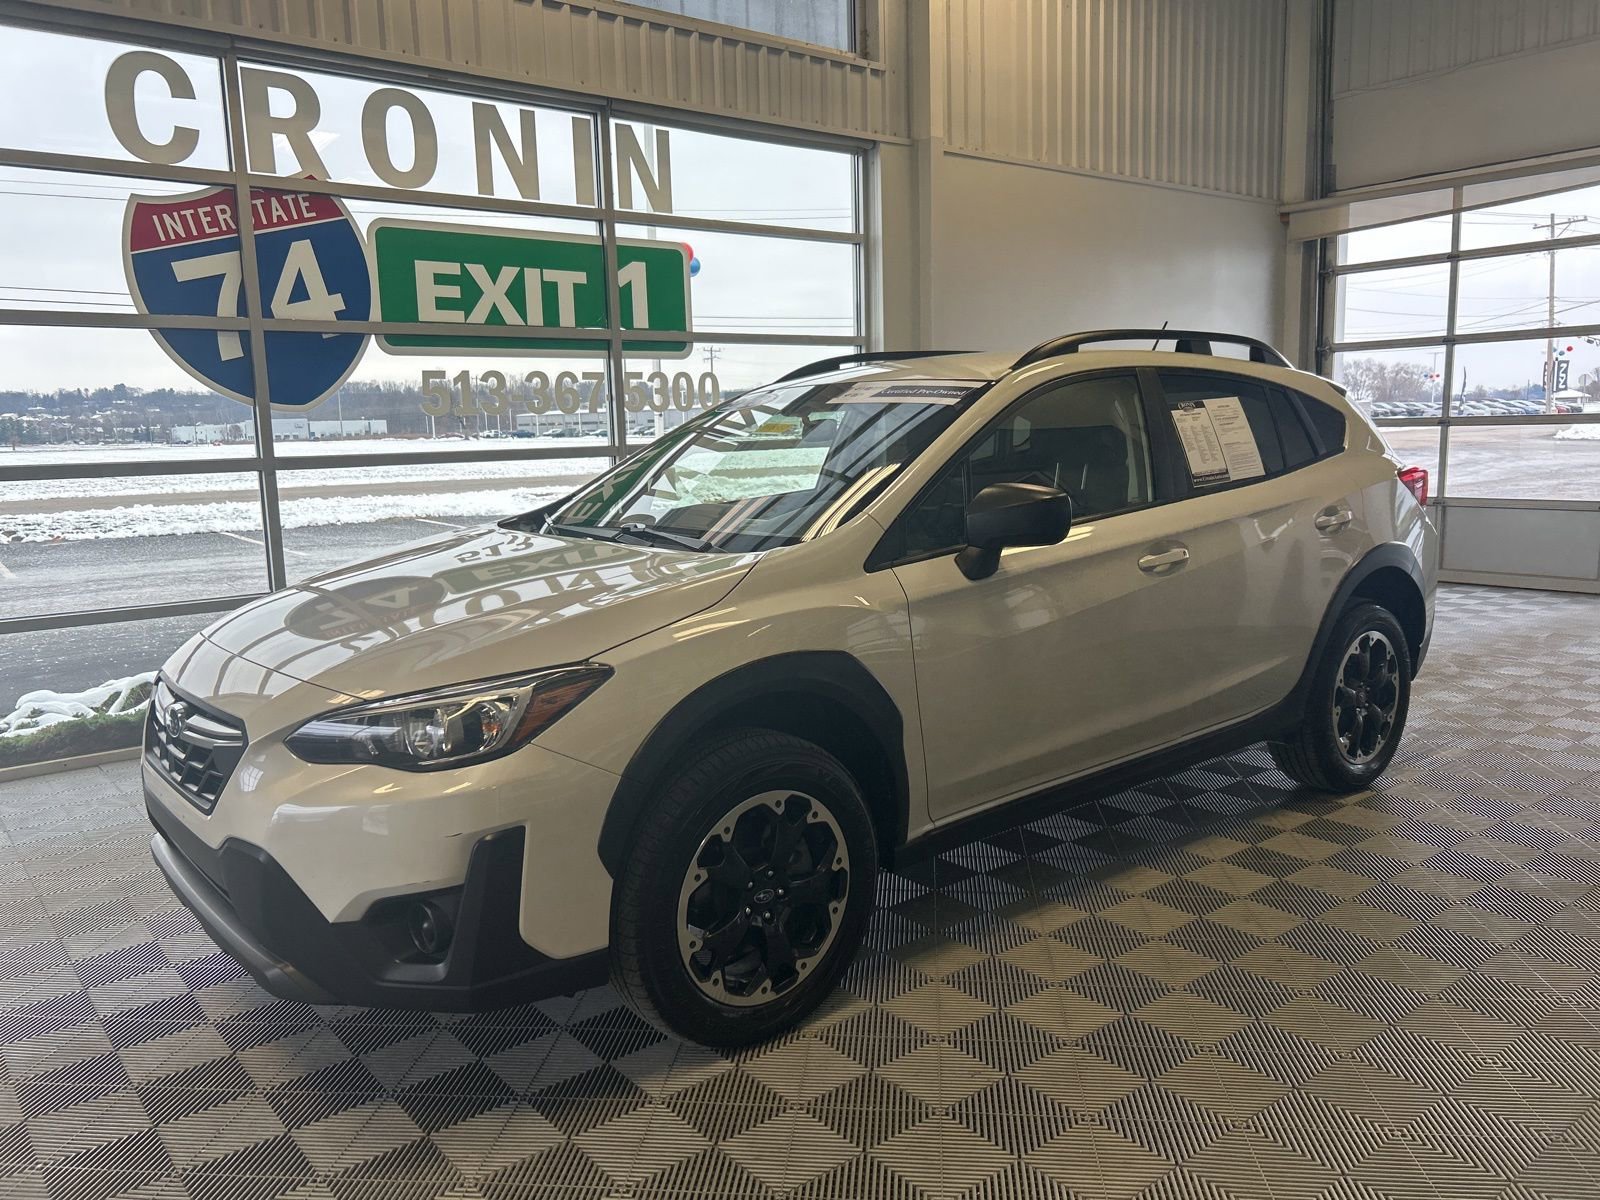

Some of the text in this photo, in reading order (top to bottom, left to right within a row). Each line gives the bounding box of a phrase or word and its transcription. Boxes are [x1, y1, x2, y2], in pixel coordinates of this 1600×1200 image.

[104, 50, 673, 214] CRONIN
[152, 193, 316, 242] INTERTATE
[171, 239, 346, 362] 74
[414, 259, 650, 329] EXIT 1
[420, 370, 720, 416] 513-3675300
